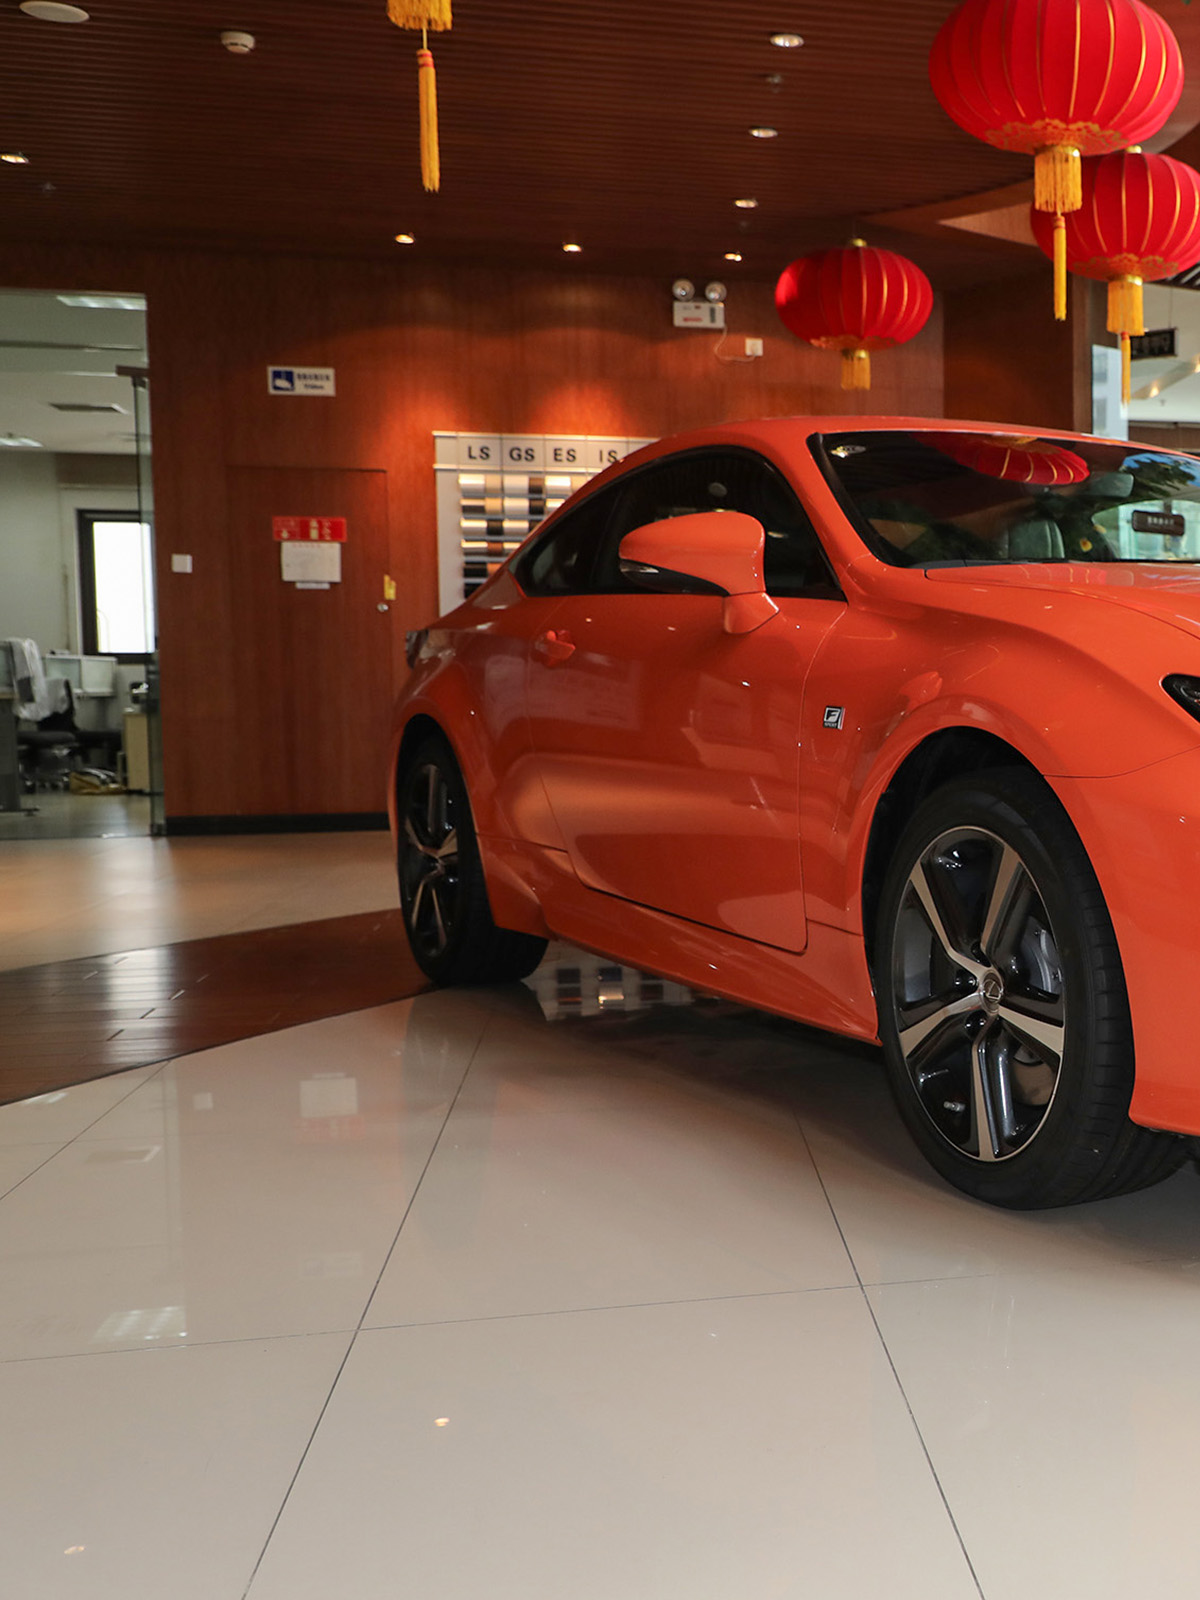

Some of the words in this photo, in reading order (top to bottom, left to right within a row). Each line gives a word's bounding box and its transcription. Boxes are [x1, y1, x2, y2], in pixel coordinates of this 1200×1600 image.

[468, 446, 490, 460] LS
[509, 447, 535, 462] GS
[554, 448, 577, 462] ES
[599, 450, 618, 463] IS
